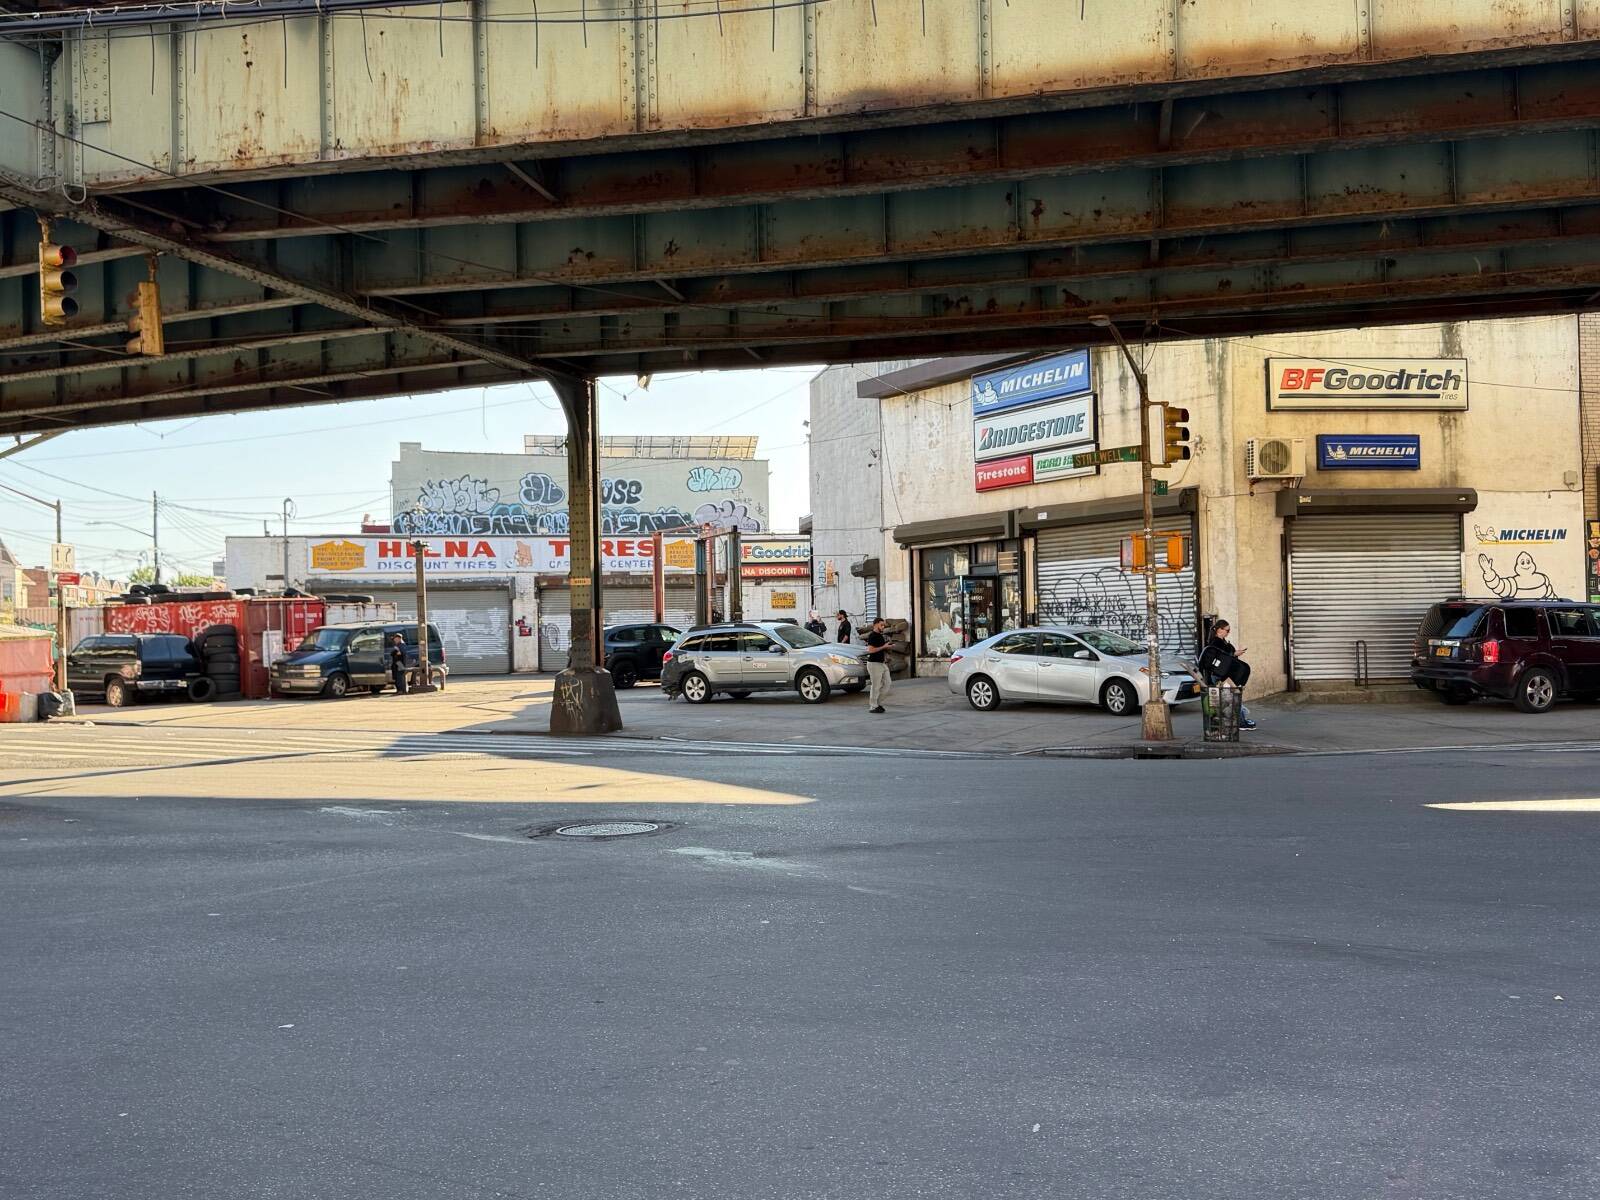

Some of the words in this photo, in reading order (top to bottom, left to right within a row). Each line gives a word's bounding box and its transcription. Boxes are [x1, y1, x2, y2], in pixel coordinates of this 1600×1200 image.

[1000, 362, 1085, 394] MICHELIN
[1279, 368, 1462, 391] BFGoodrich
[1440, 391, 1459, 401] Tires
[978, 412, 1086, 451] BRIDGESTONE
[1075, 449, 1124, 467] STILLWELL
[1349, 446, 1417, 456] MICHELIN
[976, 464, 1027, 485] Firestone
[1499, 528, 1568, 541] MICHELIN
[548, 540, 656, 557] TRES
[377, 561, 449, 570] DISCUNT
[454, 561, 498, 570] TIRES
[758, 567, 798, 576] DISCOUNT
